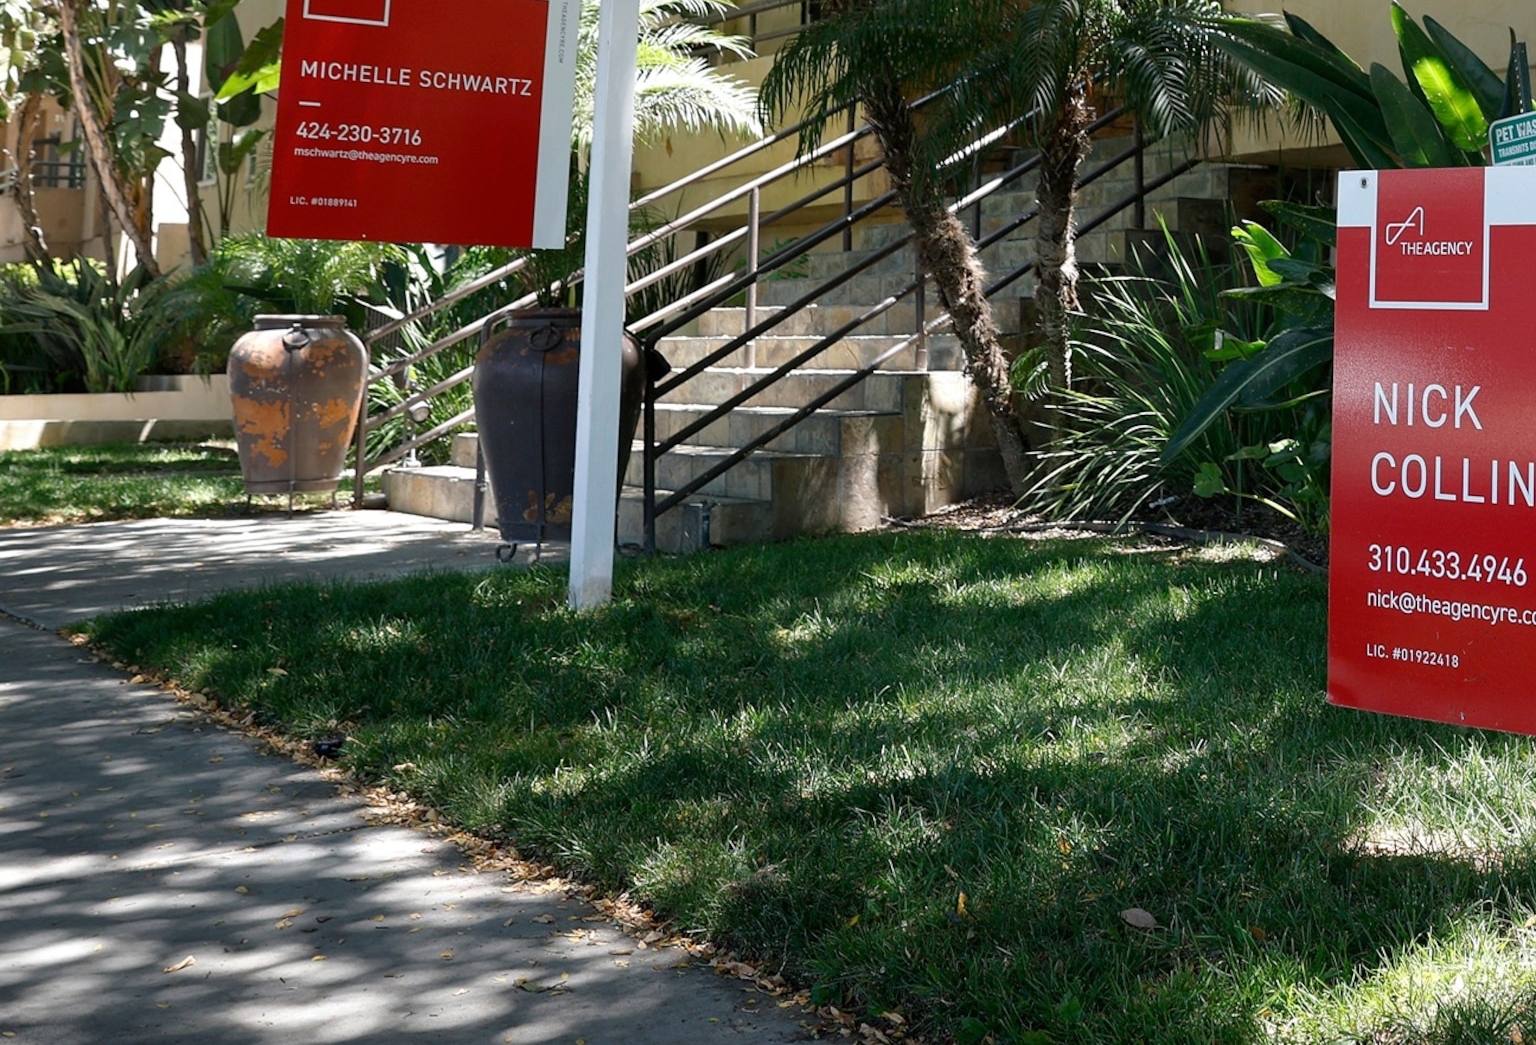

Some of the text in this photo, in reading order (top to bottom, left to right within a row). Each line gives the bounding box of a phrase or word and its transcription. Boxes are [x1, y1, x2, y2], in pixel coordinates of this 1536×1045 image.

[301, 59, 533, 97] MICHELLE SCHWARTZ
[296, 121, 422, 146] 424-230-3716
[1495, 124, 1515, 143] PET
[294, 147, 439, 165] mschwartz@theagencyre.com
[1498, 142, 1529, 158] TRANSMITS
[290, 195, 309, 206] LIC.
[1400, 241, 1473, 256] THEAGENCY
[1373, 381, 1483, 430] NICK
[1368, 544, 1528, 587] 310.433.4946
[1366, 643, 1459, 668] LIC. #01922418
